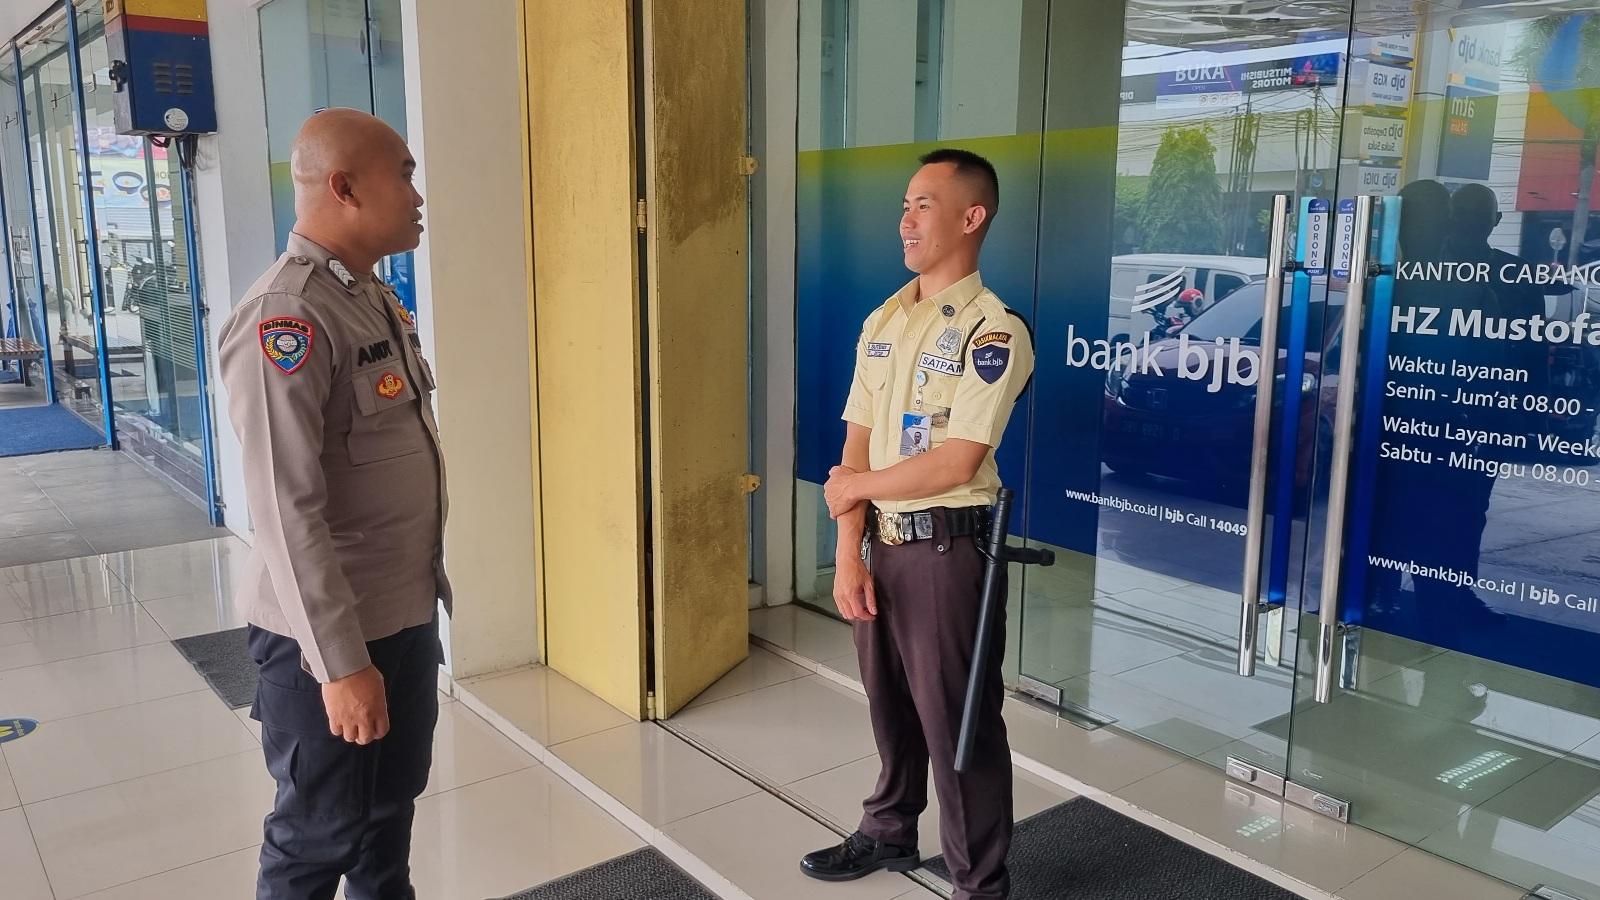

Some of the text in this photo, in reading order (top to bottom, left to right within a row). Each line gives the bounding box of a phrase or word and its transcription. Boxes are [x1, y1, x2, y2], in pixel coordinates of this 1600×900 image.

[1175, 63, 1225, 82] BUKA
[1310, 214, 1321, 267] DORONG
[1341, 215, 1352, 269] DORONG
[1395, 261, 1491, 283] KANTOR
[1390, 305, 1441, 336] HZ
[922, 356, 964, 374] SATPAM
[977, 358, 1004, 367] bank bjb
[1066, 324, 1260, 393] bank bjb
[1388, 354, 1529, 383] Waktu layanan
[1385, 381, 1436, 401] Senin
[1522, 394, 1581, 416] 08.00
[1382, 415, 1440, 438] Waktu
[1444, 422, 1527, 449] Layanan
[1380, 442, 1432, 464] Sabtu
[1448, 451, 1526, 479] Minggu
[1531, 463, 1590, 486] 08.00
[1065, 489, 1158, 517] www.bankbjb.co.id
[1164, 507, 1185, 524] bjb
[1186, 513, 1207, 528] Call
[1209, 518, 1248, 537] 14049
[1368, 555, 1516, 595] www.bankbjb.co.id
[1529, 585, 1560, 606] bjb
[1564, 594, 1598, 613] Call
